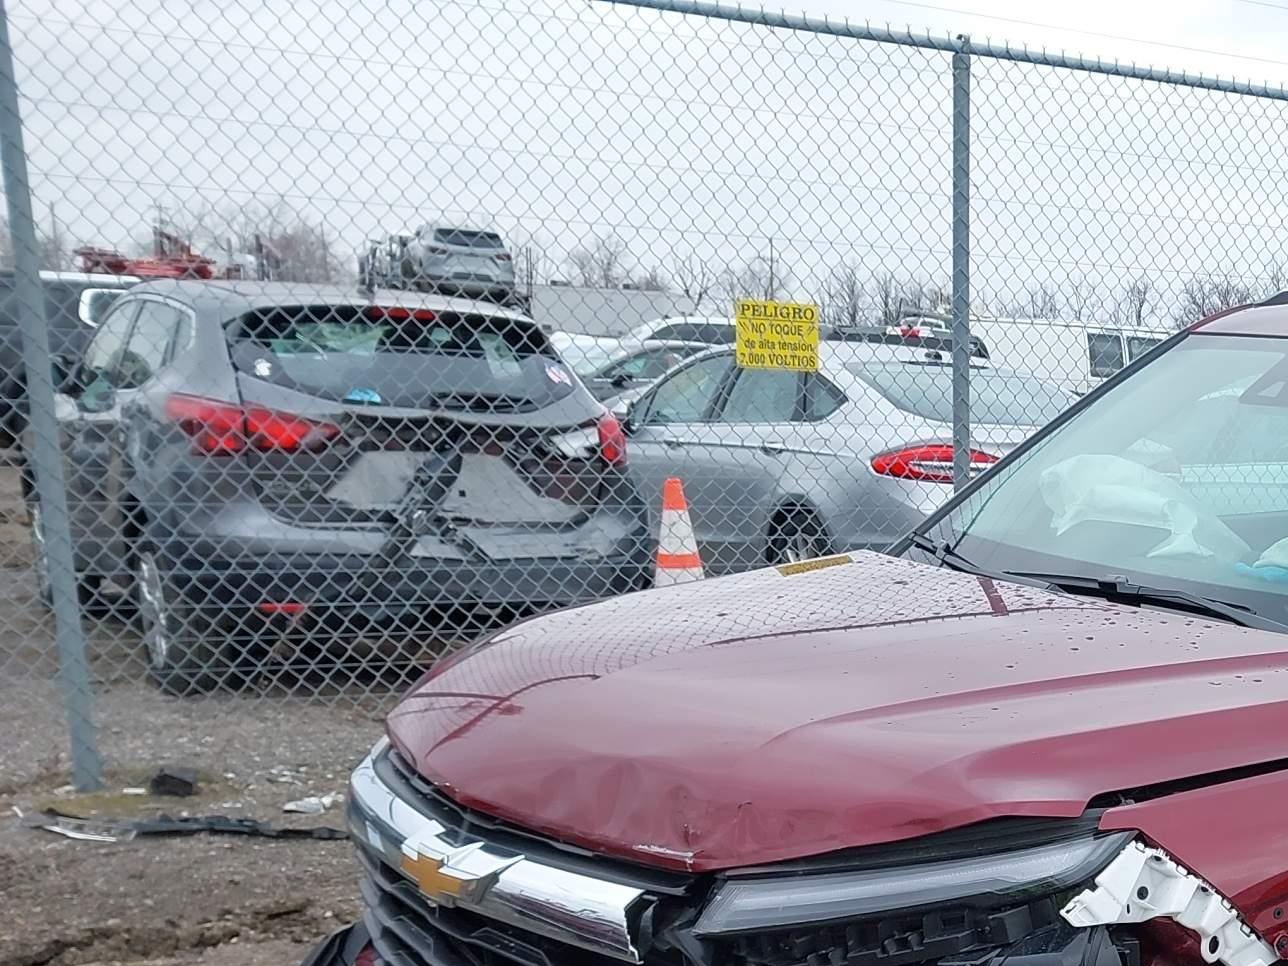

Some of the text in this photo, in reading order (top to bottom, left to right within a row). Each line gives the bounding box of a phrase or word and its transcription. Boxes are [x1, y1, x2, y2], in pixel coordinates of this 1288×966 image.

[741, 304, 815, 321] PELIGRO
[751, 322, 803, 336] NO TOQUE
[744, 338, 756, 349] de
[768, 354, 816, 368] VOLTIOS
